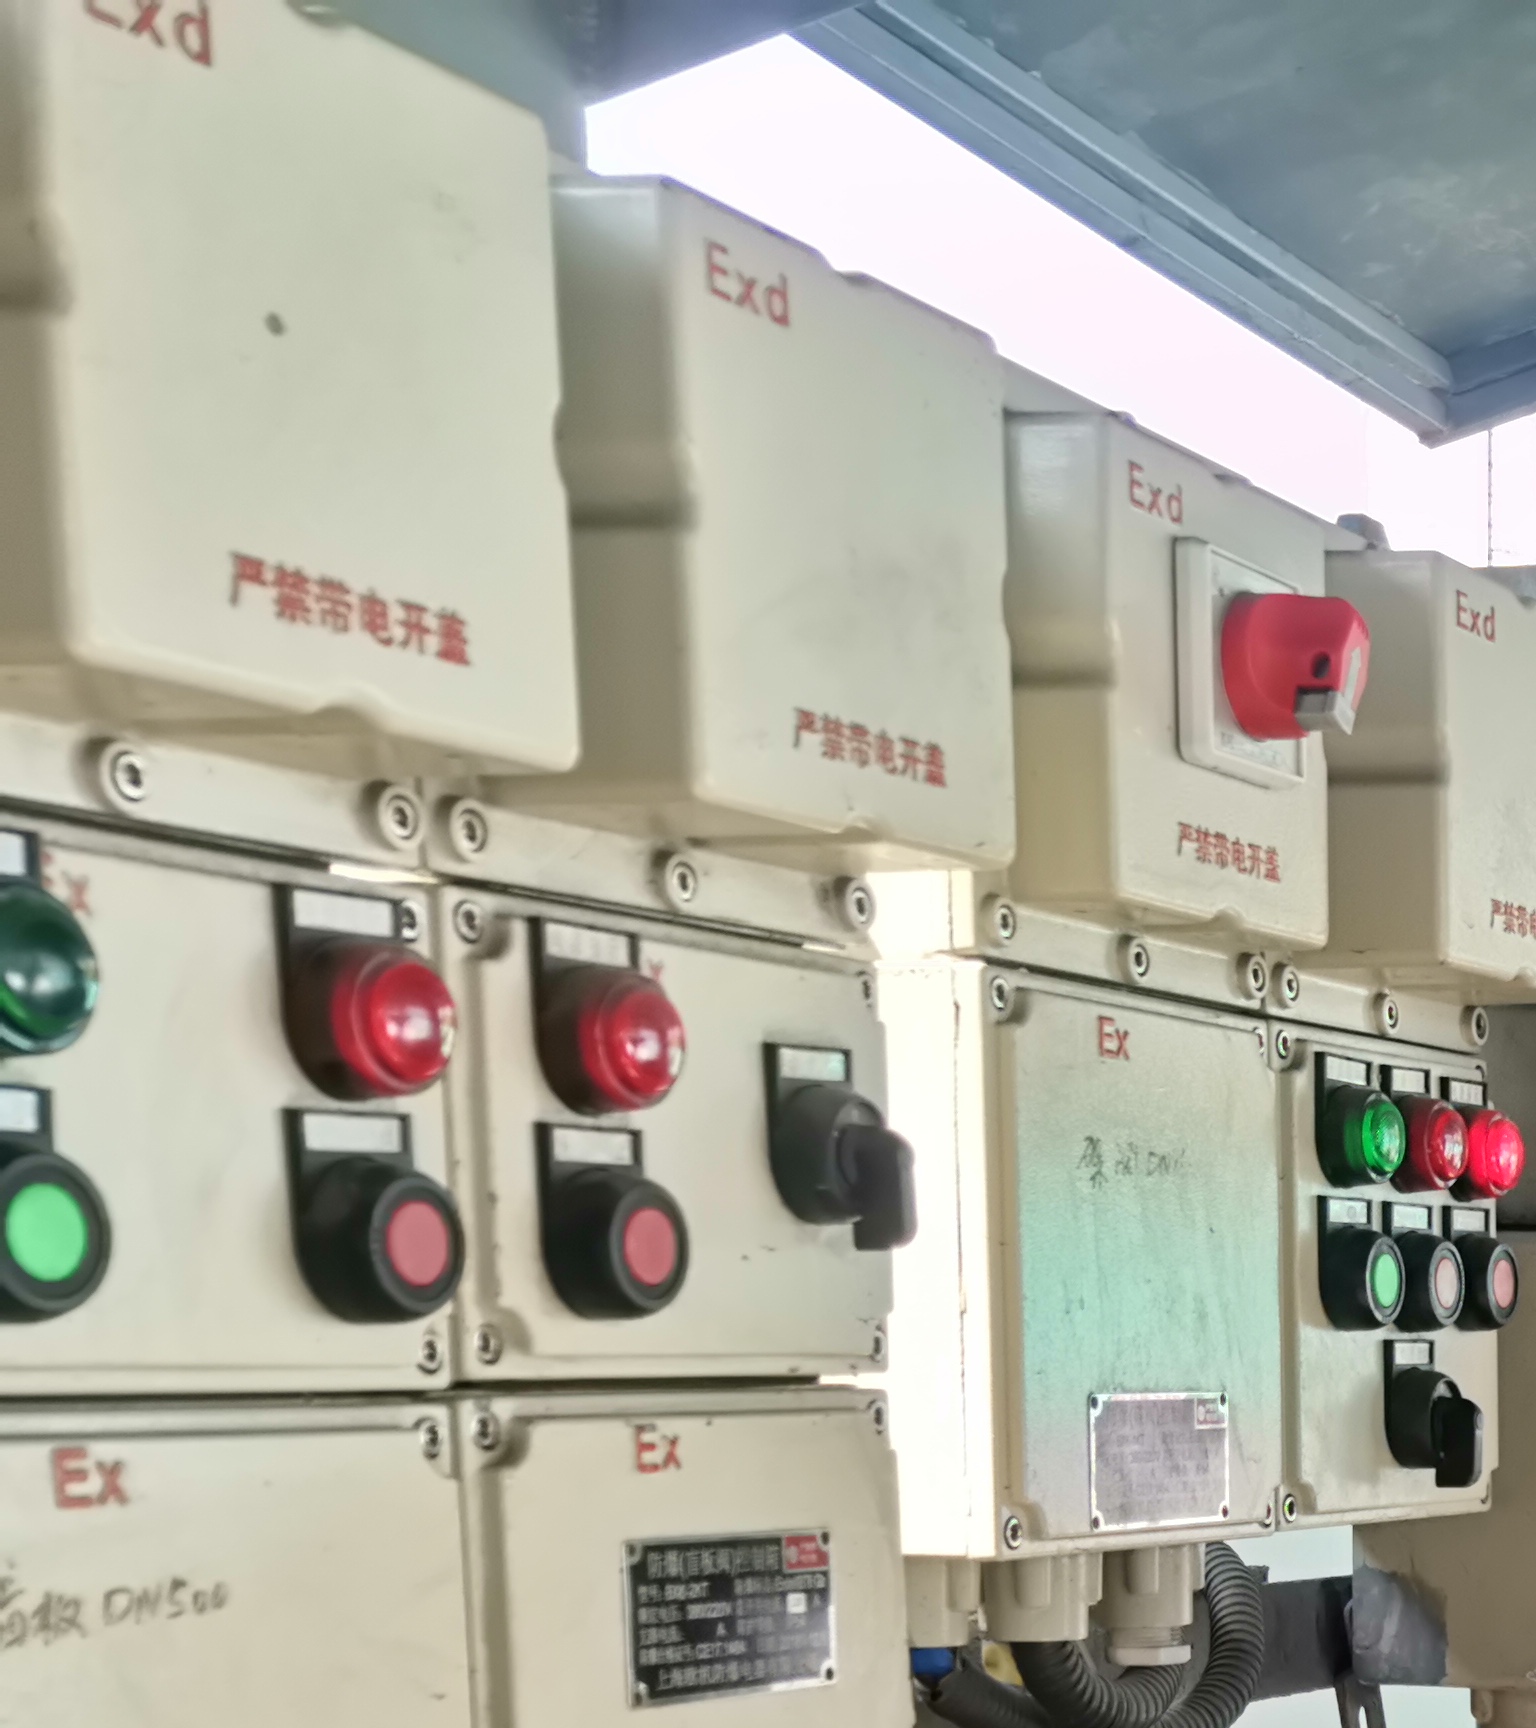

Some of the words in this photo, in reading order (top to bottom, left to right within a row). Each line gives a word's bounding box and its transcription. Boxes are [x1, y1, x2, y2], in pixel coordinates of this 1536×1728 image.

[706, 239, 791, 328] Exd
[1128, 459, 1184, 525] Exd
[229, 551, 471, 668] 严禁带电开盖
[1455, 588, 1497, 643] Exd
[793, 706, 948, 789] 严禁带电开盖
[1176, 821, 1281, 884] 严禁带电开盖
[1097, 1014, 1131, 1061] Ex
[50, 1445, 131, 1511] Ex
[633, 1424, 683, 1477] Ex
